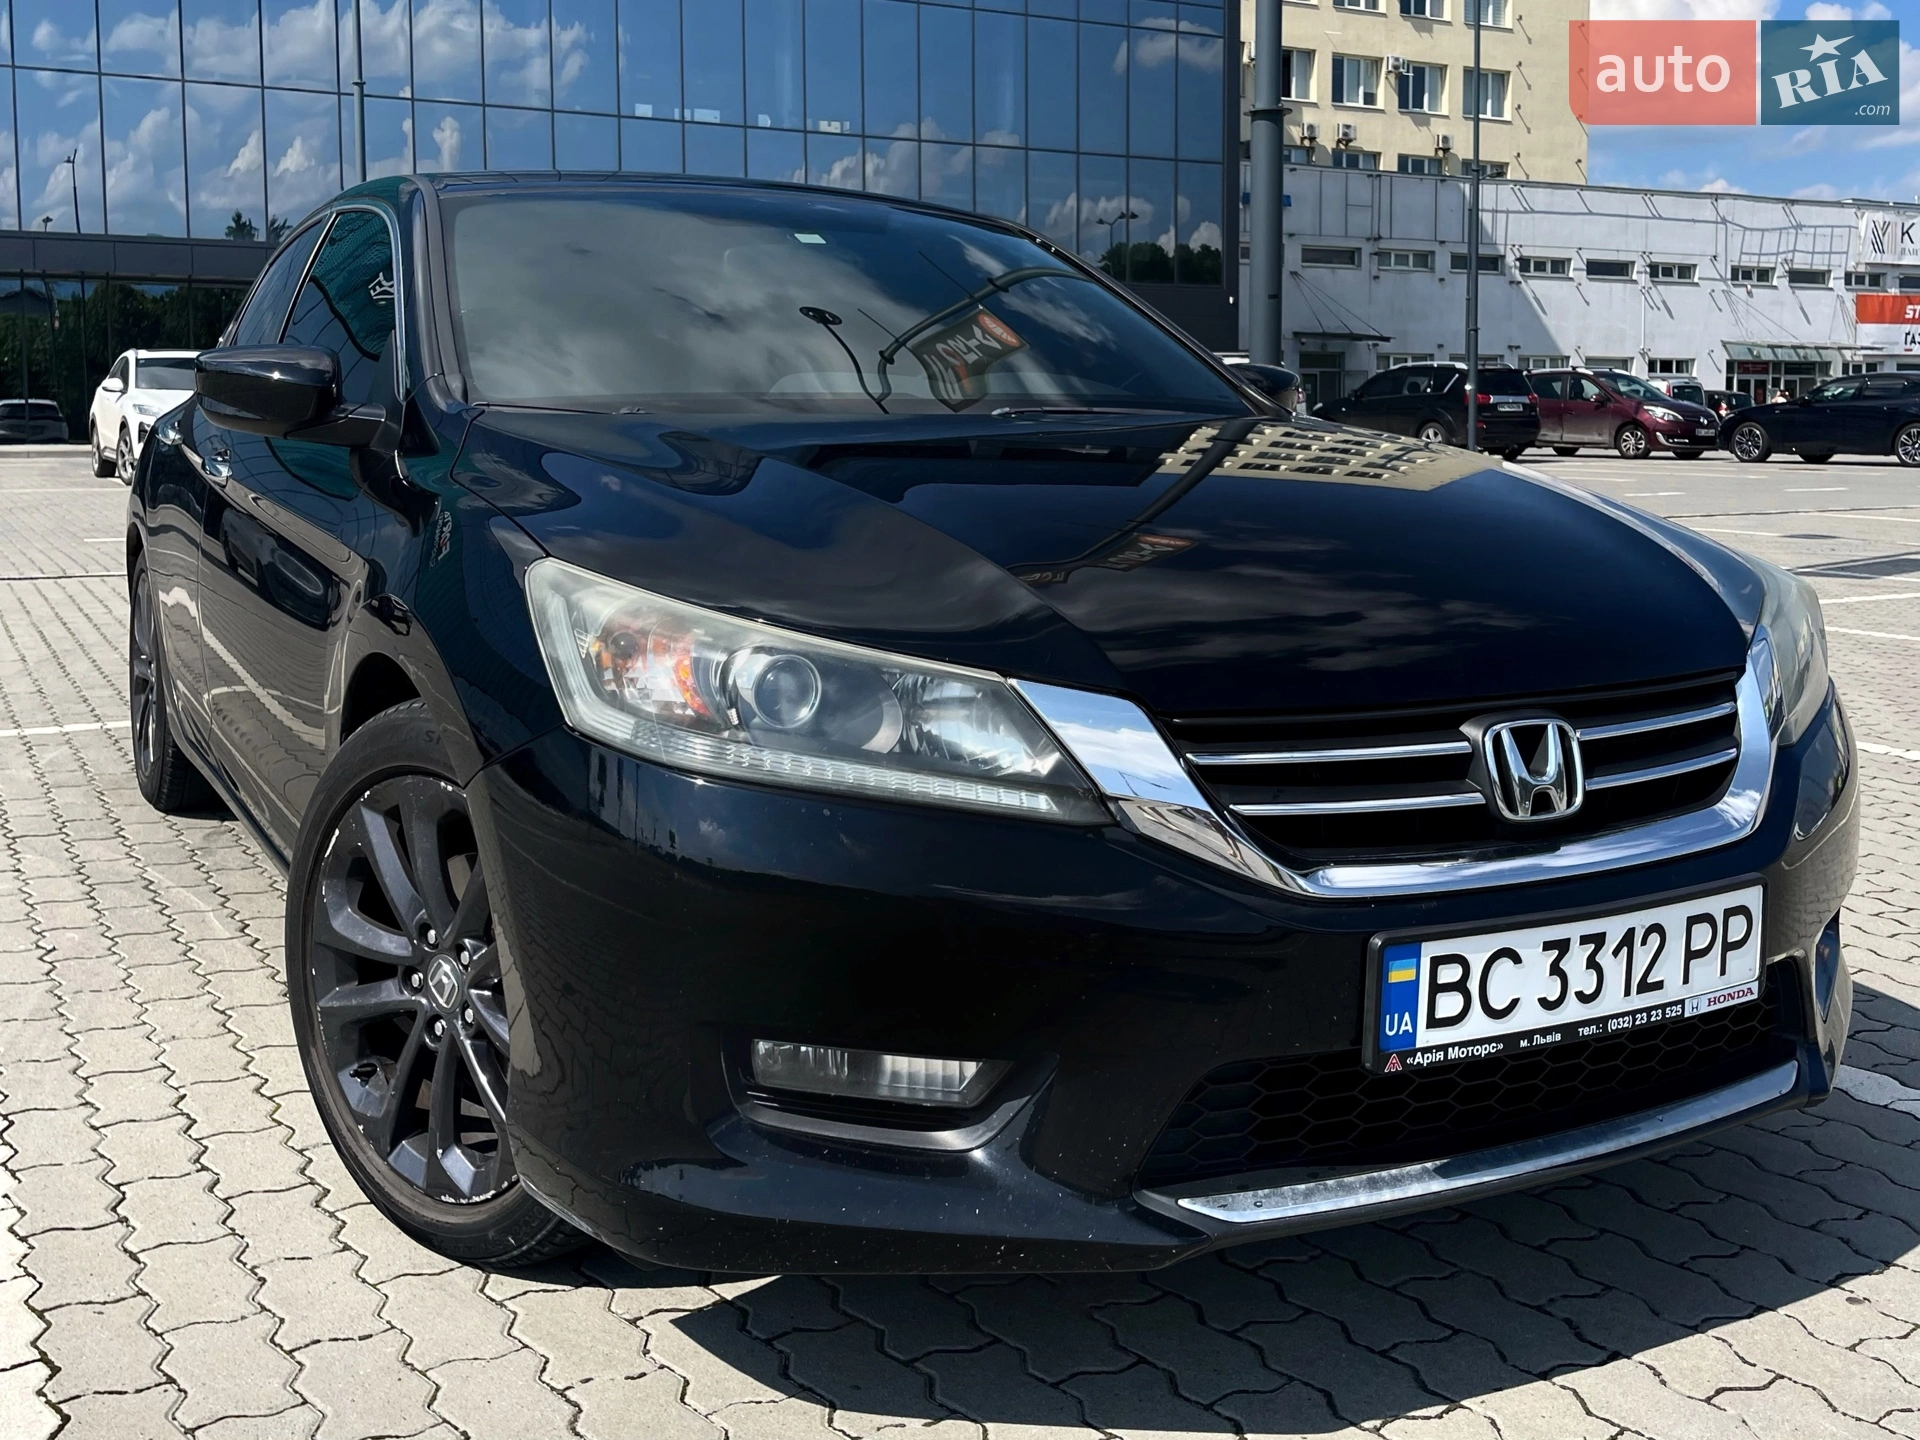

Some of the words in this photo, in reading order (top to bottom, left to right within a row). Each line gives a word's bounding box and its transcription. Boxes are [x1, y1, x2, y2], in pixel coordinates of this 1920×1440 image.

[1426, 947, 1522, 1029] BC
[1537, 922, 1666, 1011] 3312
[1680, 904, 1753, 985] PP
[1707, 987, 1755, 1007] HONDA
[1385, 1012, 1413, 1036] UA
[1406, 1047, 1444, 1067] «Арія
[1448, 1042, 1504, 1060] Моторс»
[1520, 1038, 1529, 1048] м.
[1532, 1031, 1562, 1046] Львів
[1578, 1024, 1604, 1037] тел.:
[1607, 1015, 1633, 1033] (032)
[1635, 1013, 1647, 1025] 23
[1650, 1009, 1663, 1022] 23
[1665, 1004, 1683, 1018] 525
